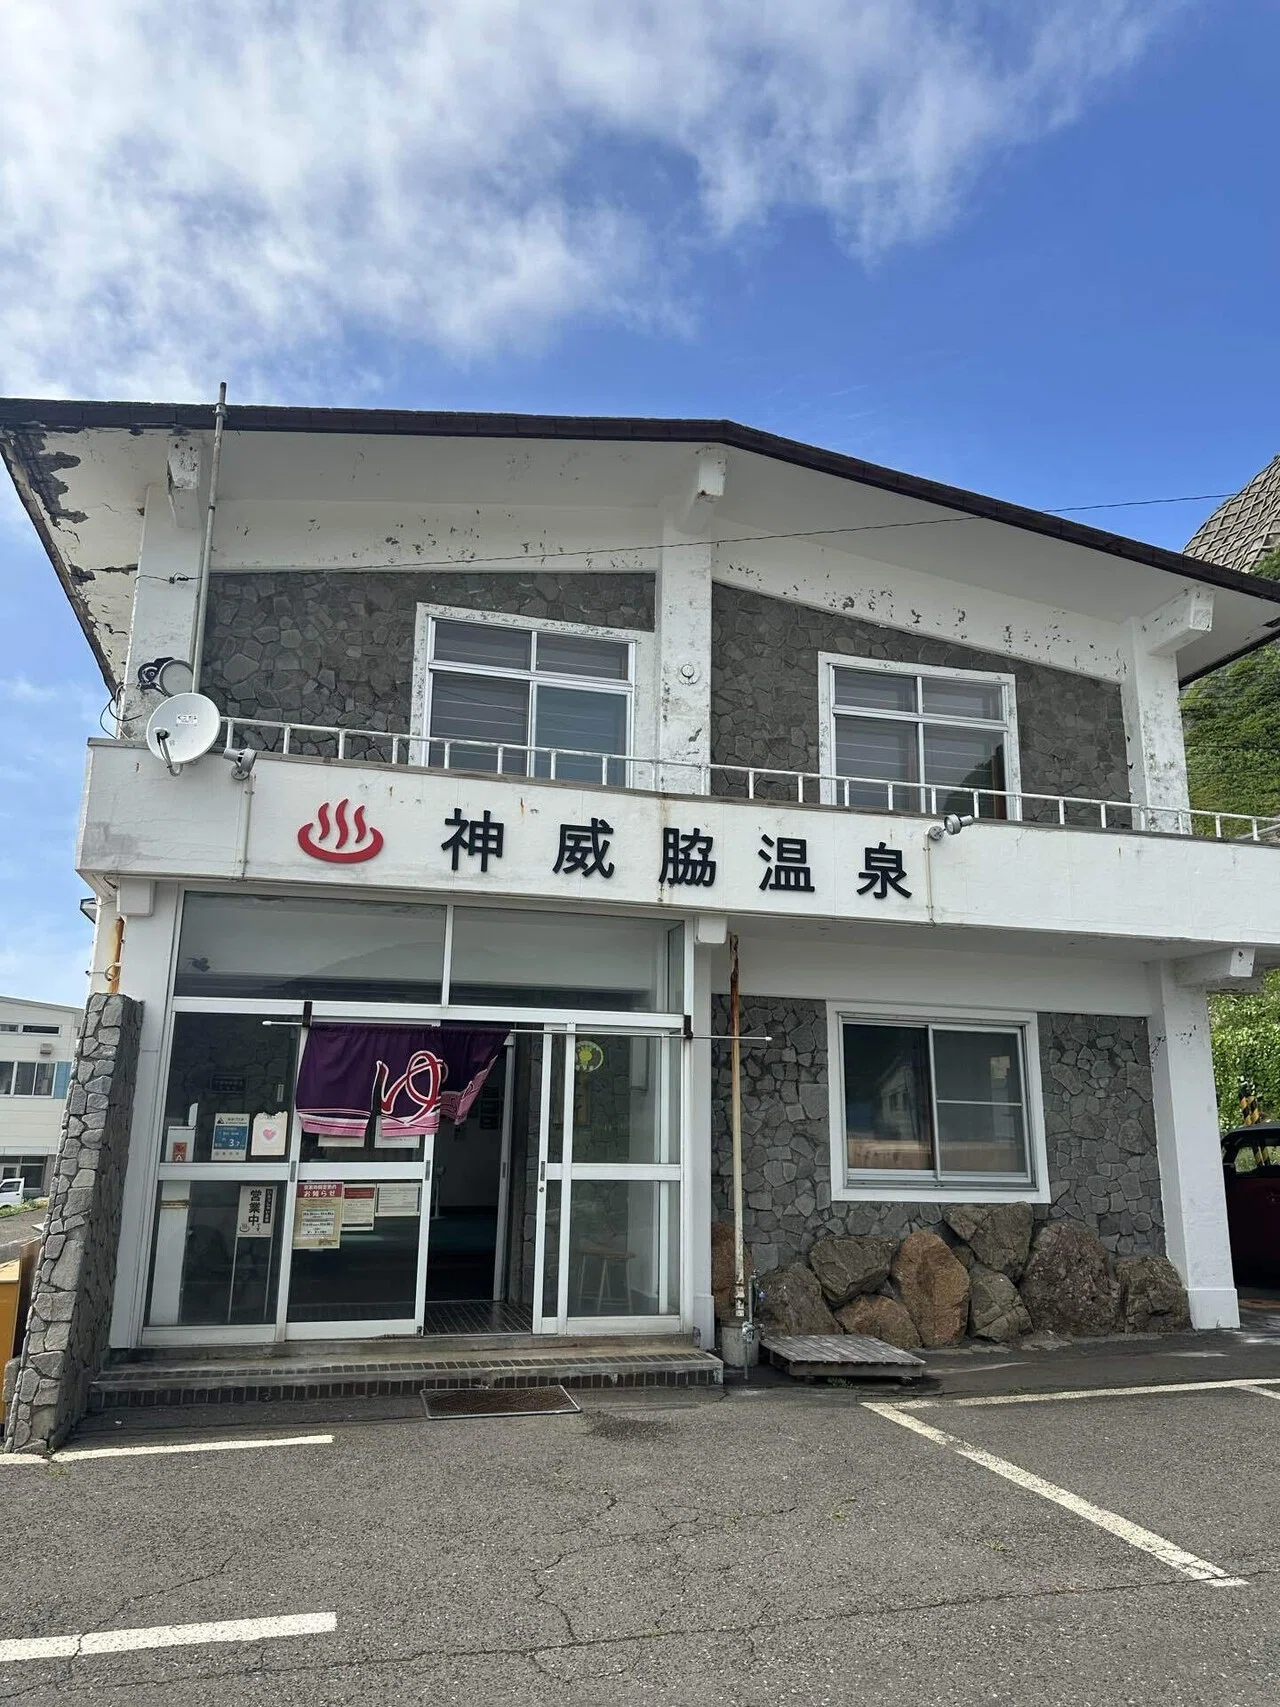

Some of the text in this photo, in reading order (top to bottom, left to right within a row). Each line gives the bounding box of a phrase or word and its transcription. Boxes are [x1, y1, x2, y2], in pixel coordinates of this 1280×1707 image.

[441, 808, 912, 898] 神威脇温泉
[371, 1050, 448, 1125] ゆ
[248, 1189, 262, 1226] 営業中
[303, 1189, 336, 1198] お知らせ
